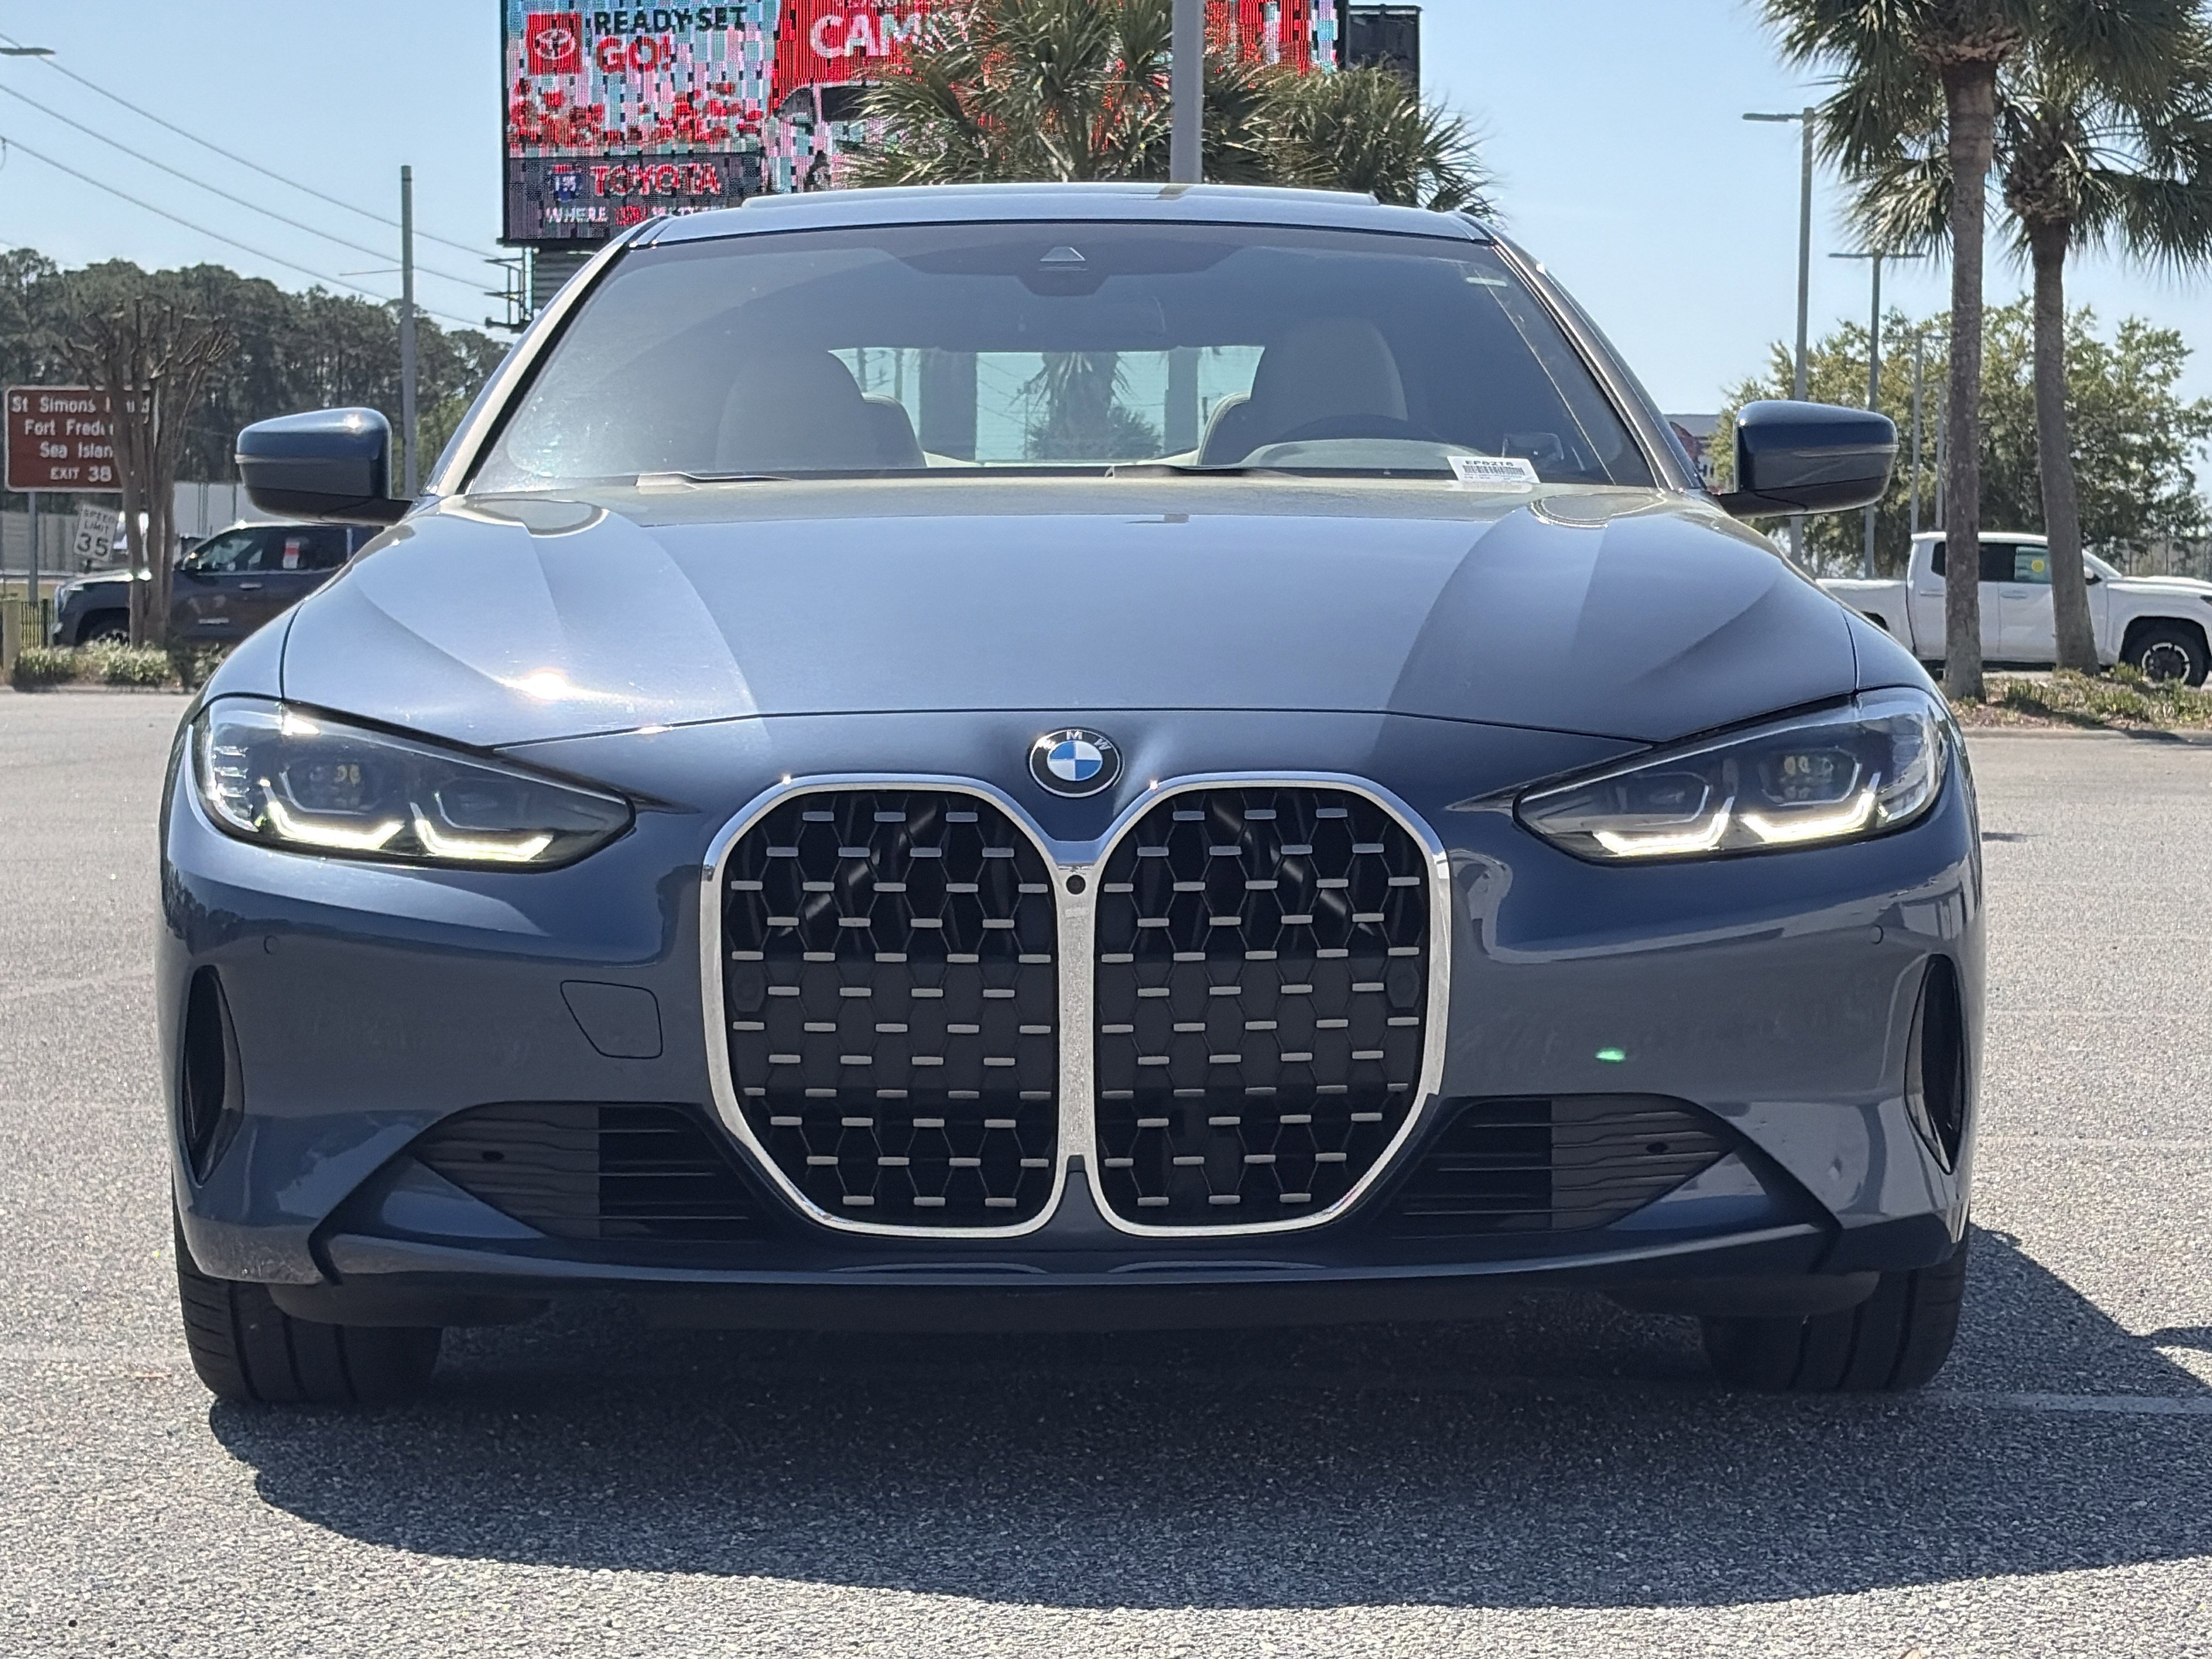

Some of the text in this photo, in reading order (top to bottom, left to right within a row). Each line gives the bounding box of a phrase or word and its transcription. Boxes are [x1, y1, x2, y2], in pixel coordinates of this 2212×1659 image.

[695, 6, 747, 31] SET
[596, 35, 671, 73] GO!
[590, 163, 721, 196] TOYOTA
[12, 396, 28, 413] St
[40, 394, 97, 413] Simons
[24, 418, 55, 436] Fort
[40, 441, 114, 459] Sea Islan
[50, 466, 111, 482] EXIT 38
[77, 532, 109, 557] 35
